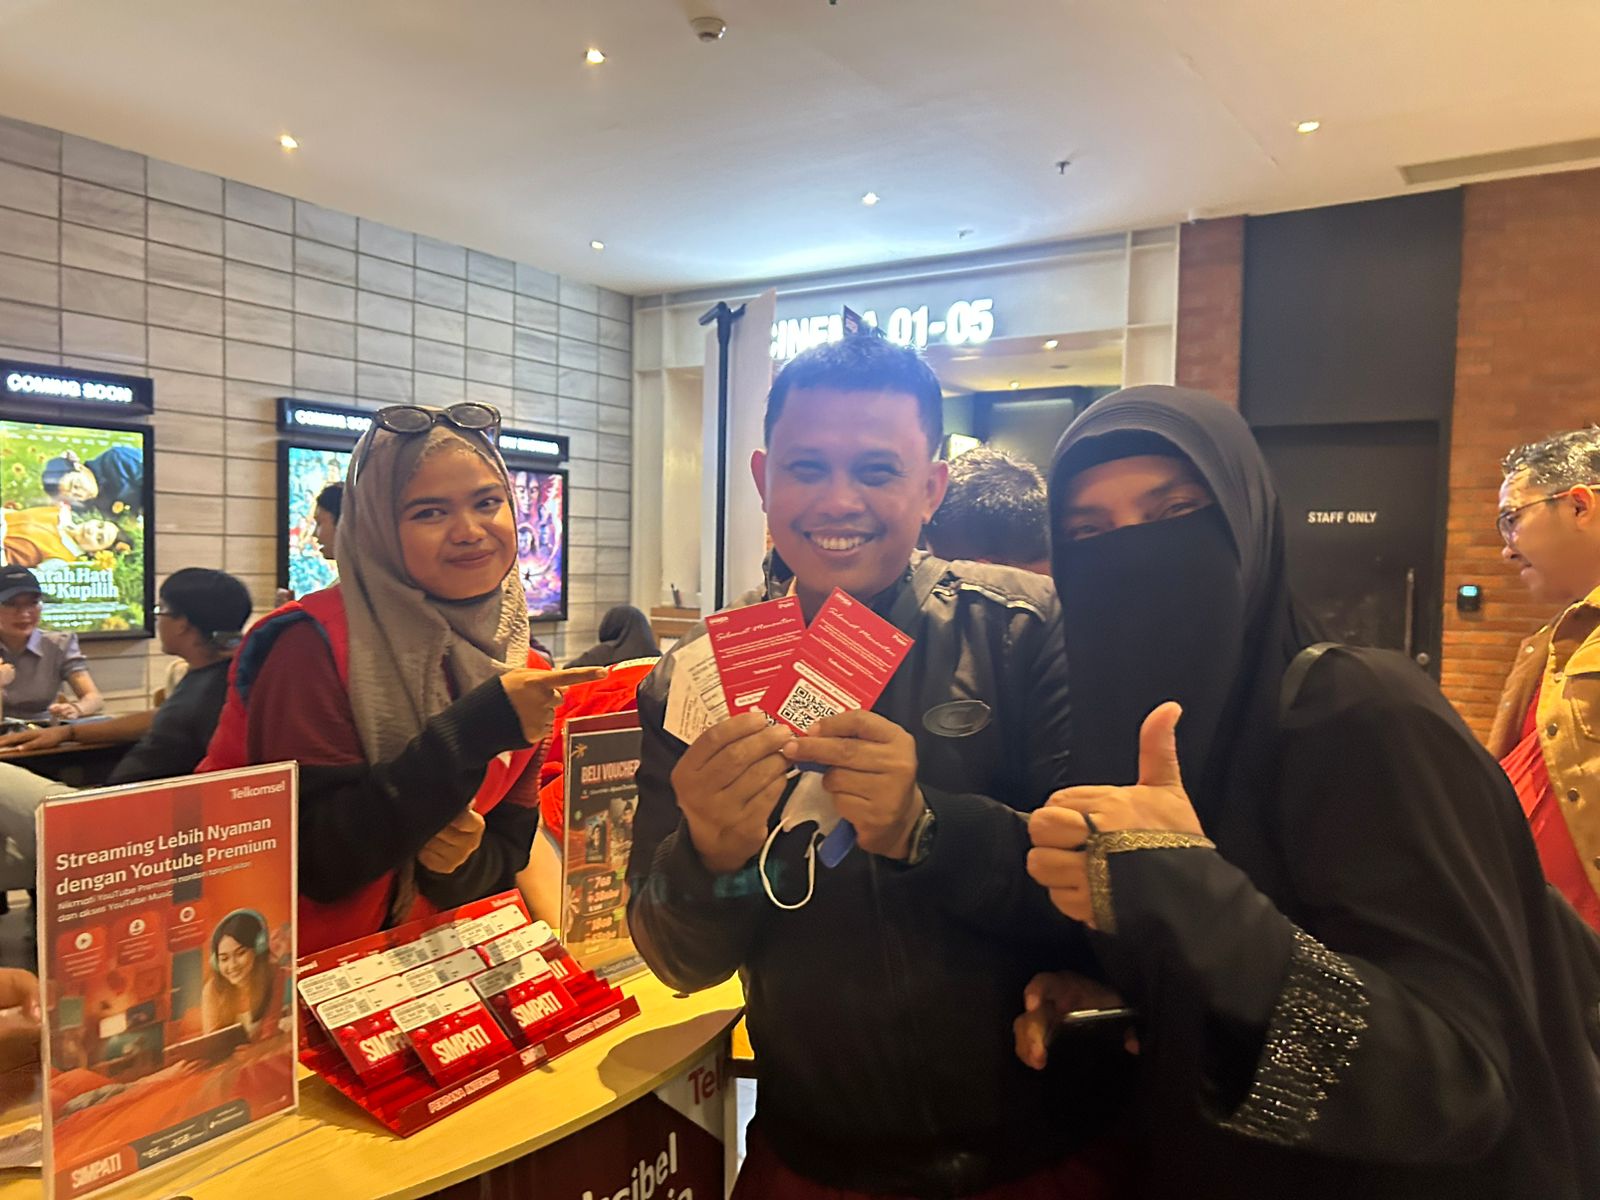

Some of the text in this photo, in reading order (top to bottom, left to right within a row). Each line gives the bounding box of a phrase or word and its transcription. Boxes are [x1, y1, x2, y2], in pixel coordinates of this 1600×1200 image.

[887, 298, 994, 348] 01-05
[7, 373, 133, 402] COMING SOON
[346, 416, 373, 431] SOO
[1307, 511, 1377, 523] STAFF ONLY
[30, 566, 114, 583] atah Hati
[56, 582, 119, 601] Kupilih
[581, 764, 601, 784] BELI
[229, 780, 286, 800] Telkomsel
[55, 817, 271, 872] Streaming Lebih Nyaman
[56, 837, 277, 896] dengan Youtube Premium
[137, 878, 178, 893] Premium
[57, 912, 78, 924] dan
[511, 990, 563, 1028] SIMPATI
[431, 1024, 491, 1064] SIMPATI
[71, 1152, 122, 1189] SIMPATI
